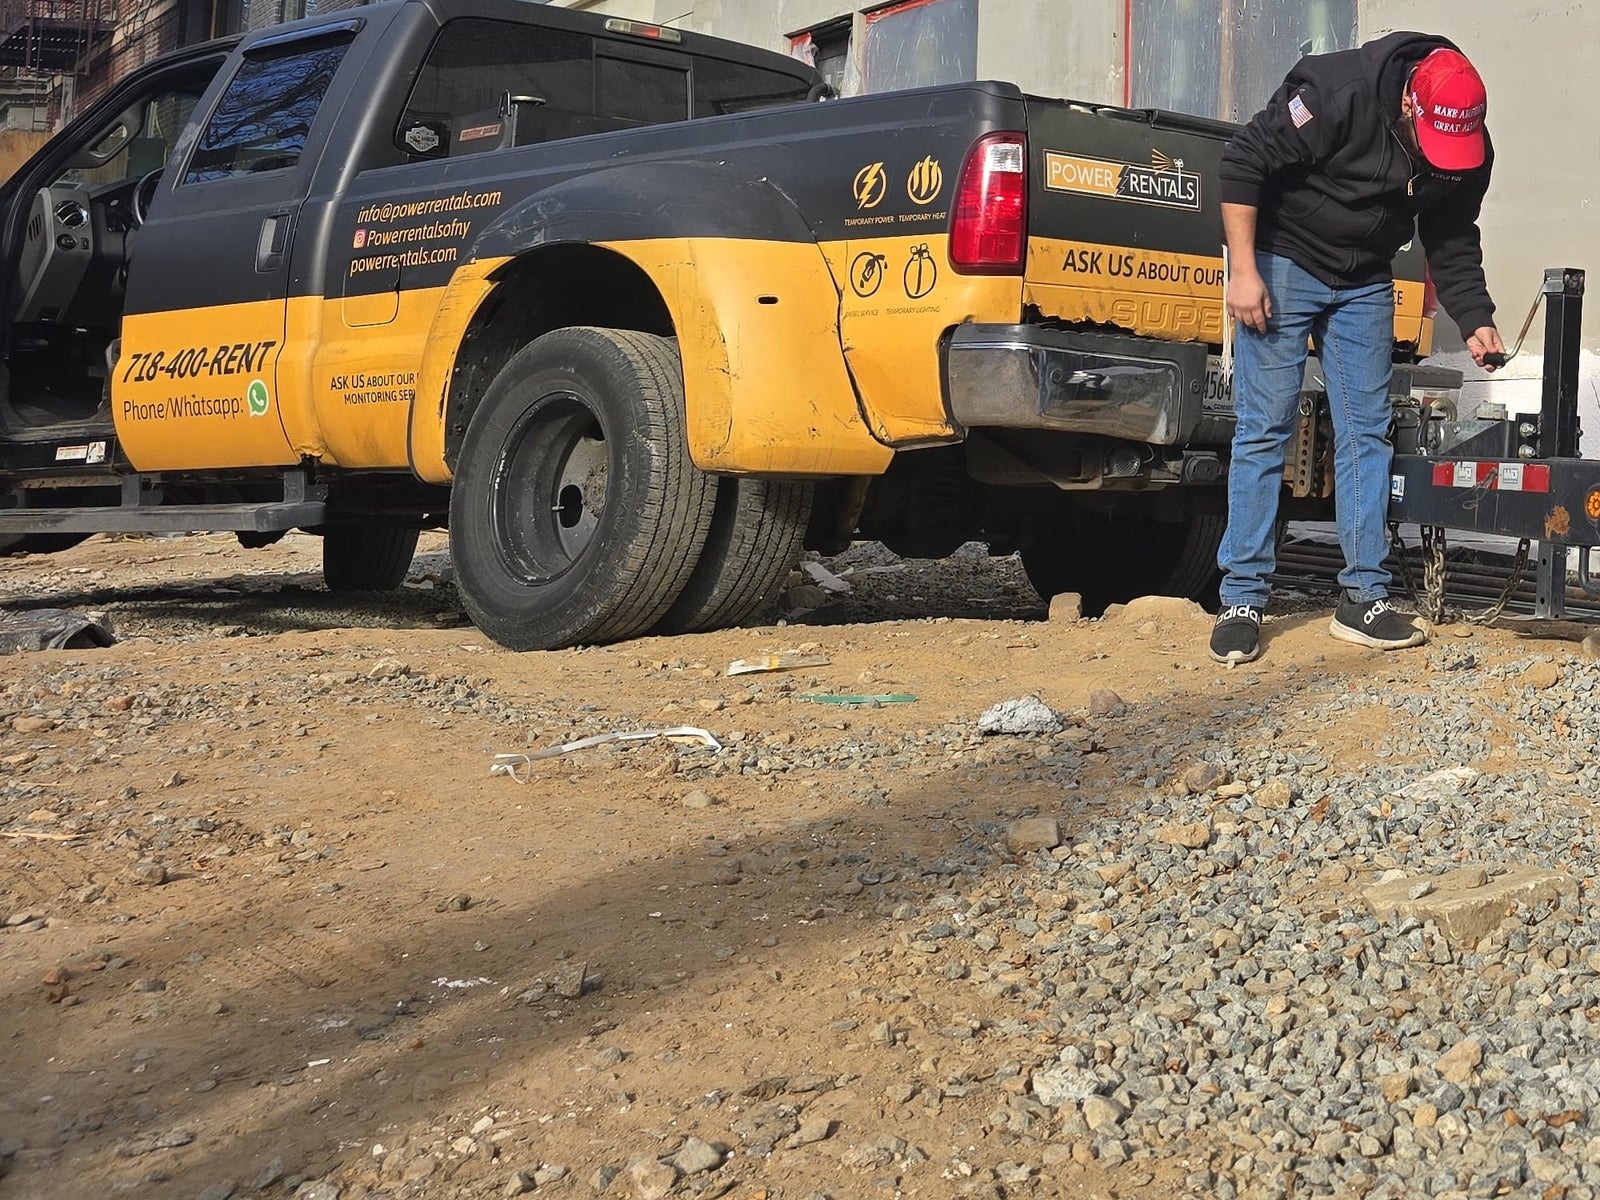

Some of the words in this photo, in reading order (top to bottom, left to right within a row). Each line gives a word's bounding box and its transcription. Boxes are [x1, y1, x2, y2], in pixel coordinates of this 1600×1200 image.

[1433, 104, 1459, 119] MAKE
[1433, 120, 1461, 133] GREAT
[1051, 161, 1115, 189] POWER
[1129, 172, 1195, 201] RENTALS
[356, 190, 502, 224] info@powerrentals.com
[898, 213, 932, 223] TEMPORARY
[932, 211, 947, 221] HEAT
[367, 217, 471, 247] Powerrentalsofny
[844, 217, 875, 227] TEMPORARY
[874, 215, 895, 224] POWER
[350, 246, 457, 278] powerrentals.com
[1062, 249, 1102, 275] ASK
[1108, 253, 1135, 278] US
[1136, 262, 1191, 284] ABOUT
[1193, 267, 1225, 287] OUR
[1111, 298, 1224, 337] SUPE
[122, 340, 277, 383] 718-400-RENT
[330, 375, 350, 391] ASK
[351, 374, 365, 389] US
[366, 374, 395, 388] ABOUT
[396, 372, 416, 385] OUR
[123, 394, 244, 421] Phone/Whatsapp:
[344, 390, 398, 405] MONITORING
[1216, 604, 1262, 626] adida
